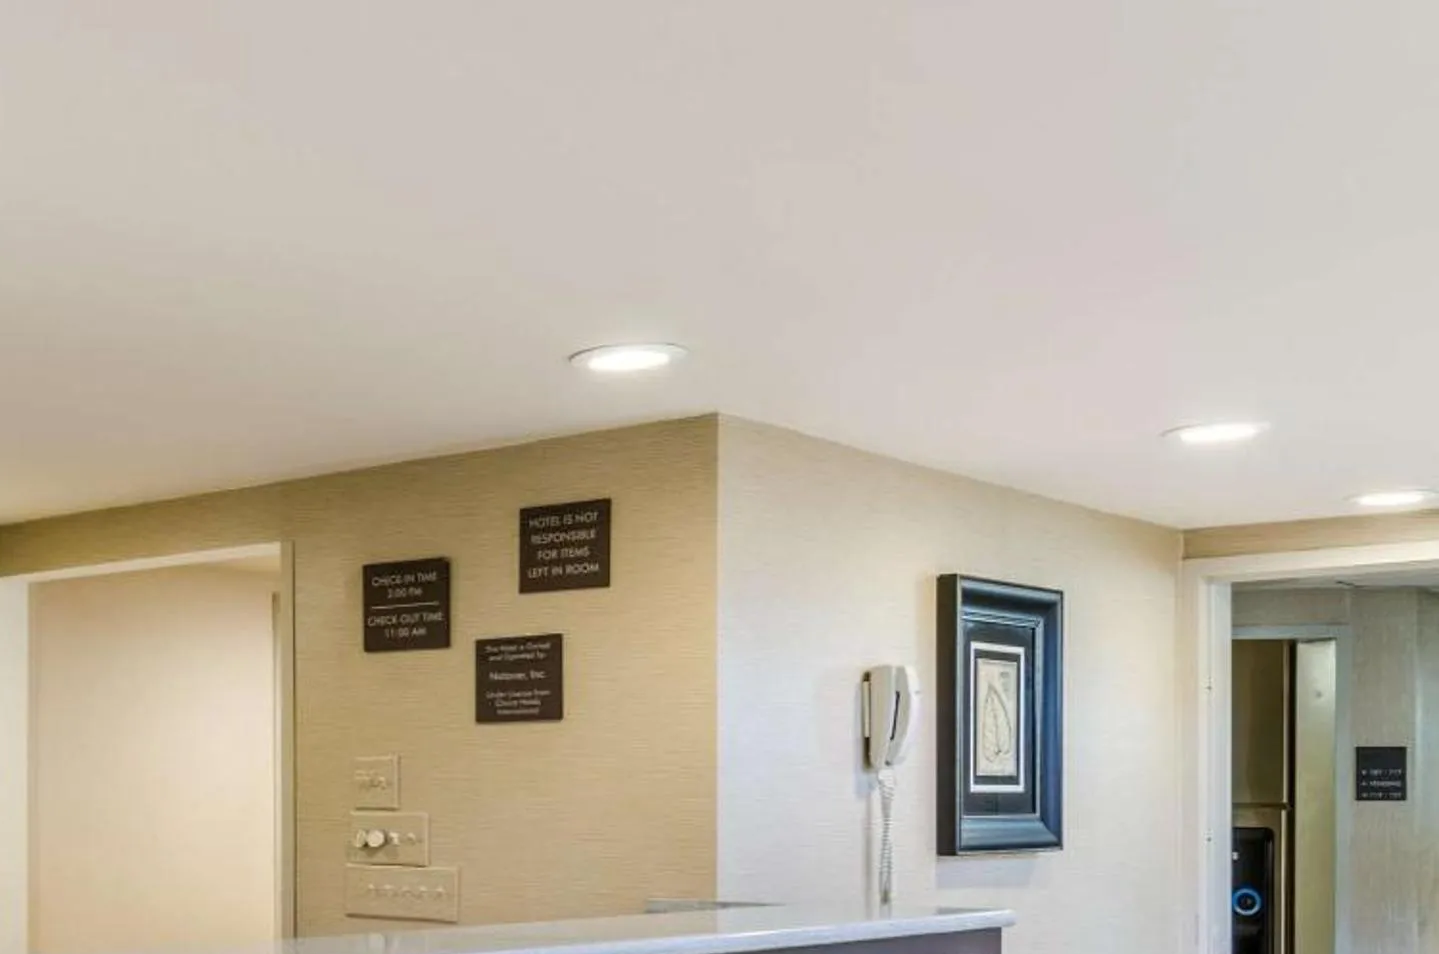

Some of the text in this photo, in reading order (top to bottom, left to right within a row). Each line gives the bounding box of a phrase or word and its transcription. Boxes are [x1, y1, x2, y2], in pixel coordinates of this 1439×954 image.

[529, 511, 599, 528] HOTEL IS NOT
[530, 528, 596, 544] RESPONSIBLE
[537, 546, 590, 560] FOR ITEMS
[527, 561, 599, 578] LEFT IN ROOM
[421, 610, 444, 623] TIME
